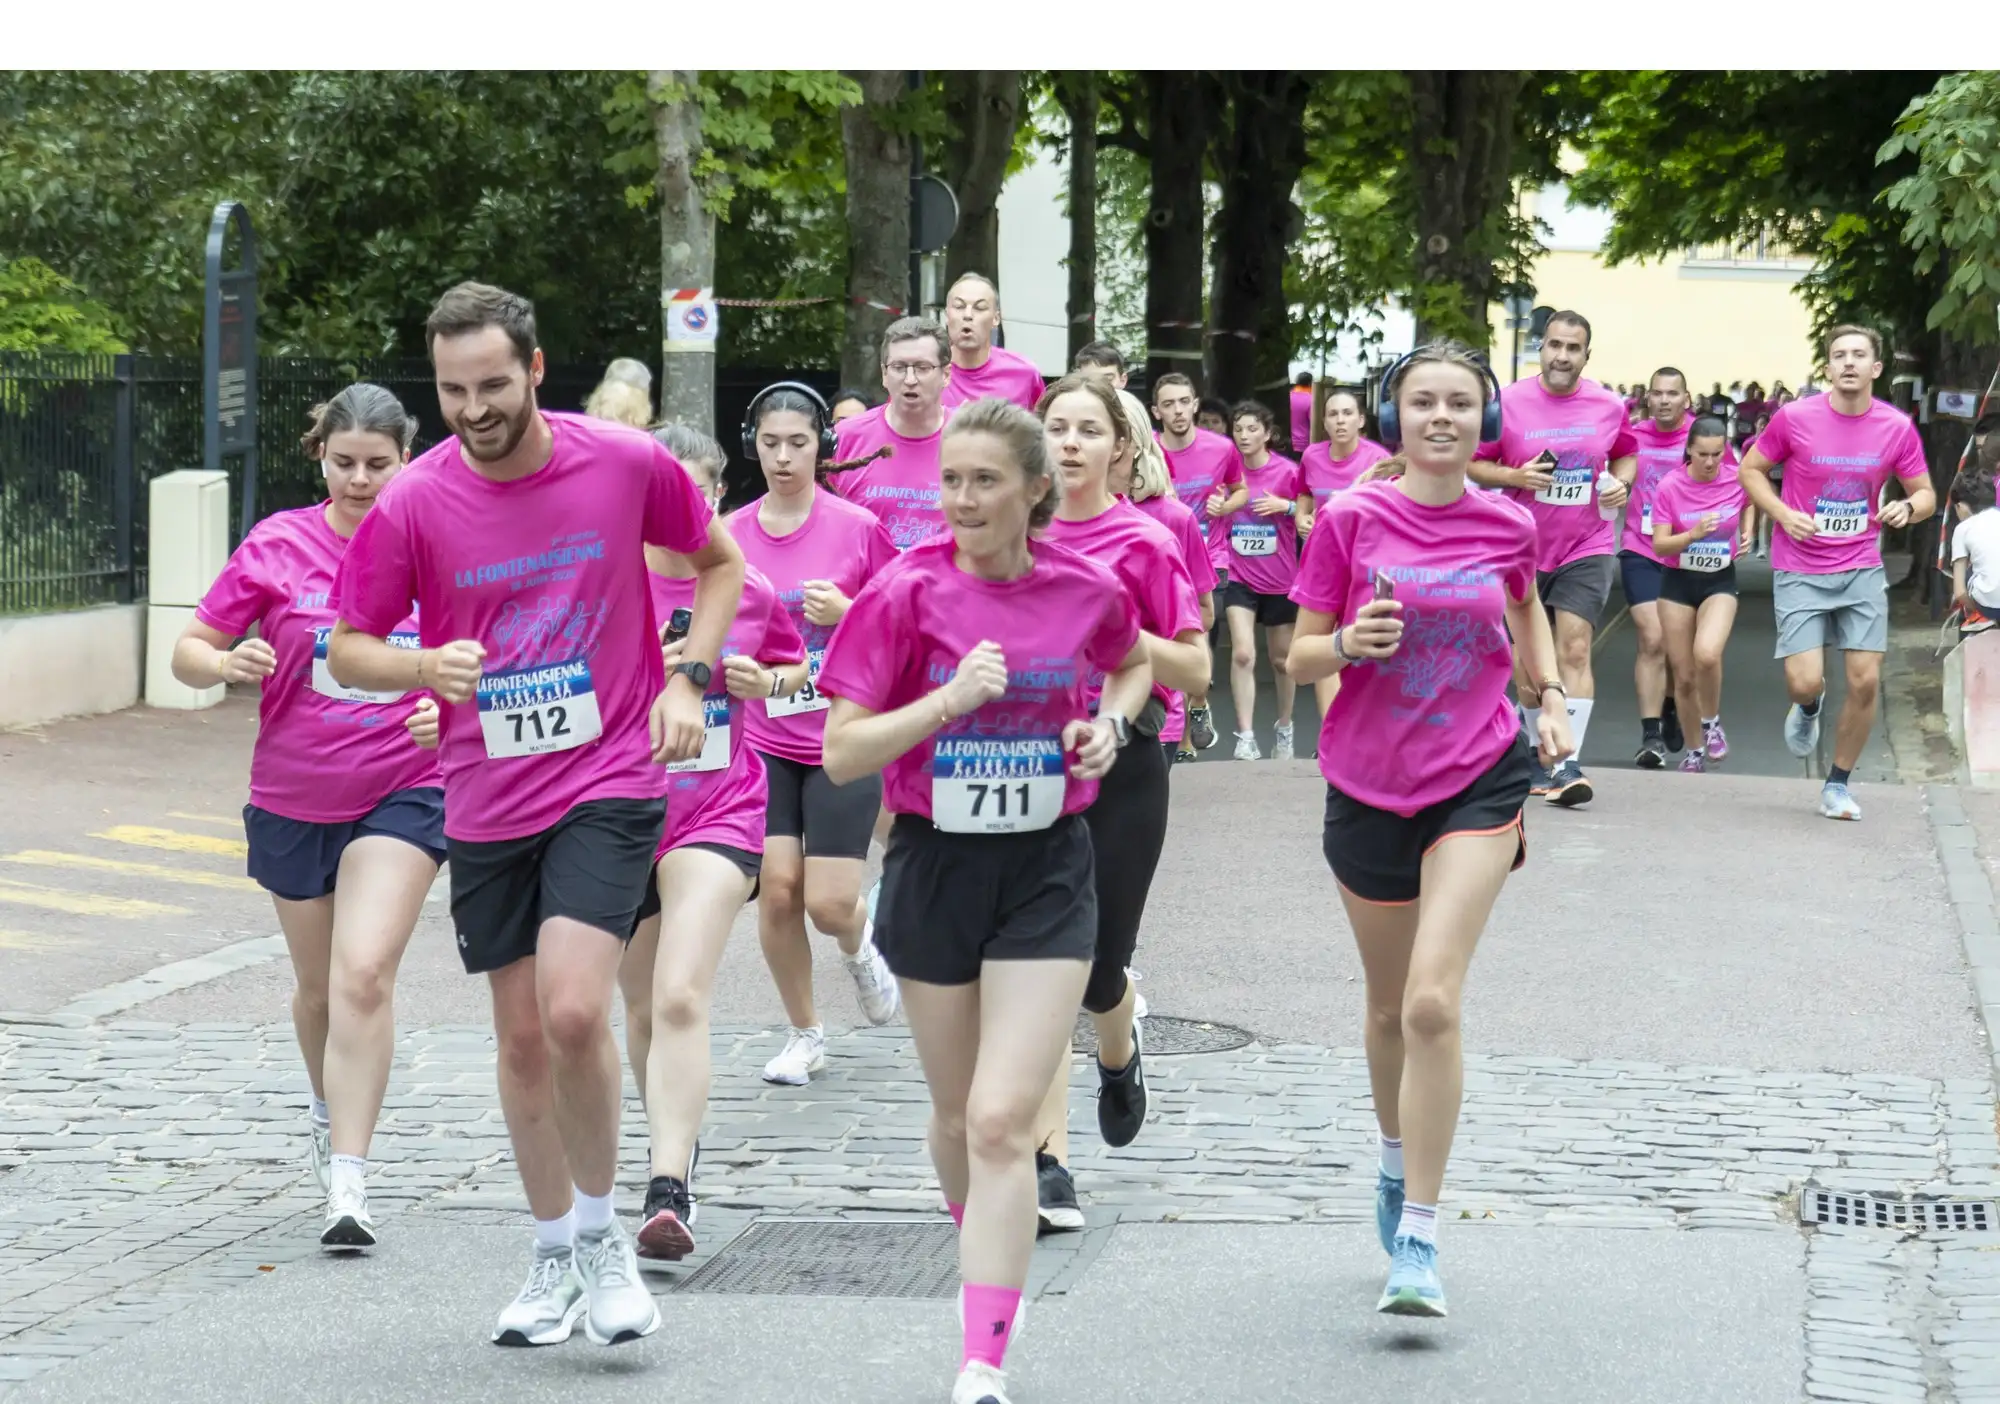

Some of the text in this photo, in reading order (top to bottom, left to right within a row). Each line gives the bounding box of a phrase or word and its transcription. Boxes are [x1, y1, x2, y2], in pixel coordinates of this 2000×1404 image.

[1547, 484, 1582, 499] 1147
[1823, 518, 1858, 532] 1031
[1242, 539, 1265, 550] 722
[455, 540, 605, 588] LA FONTENAISIENNE
[1688, 555, 1722, 569] 1029
[487, 660, 586, 692] FONTENAISIENNE
[505, 706, 571, 742] 712
[935, 740, 1060, 757] LA FONTENAISIENNE
[966, 783, 1029, 817] 711
